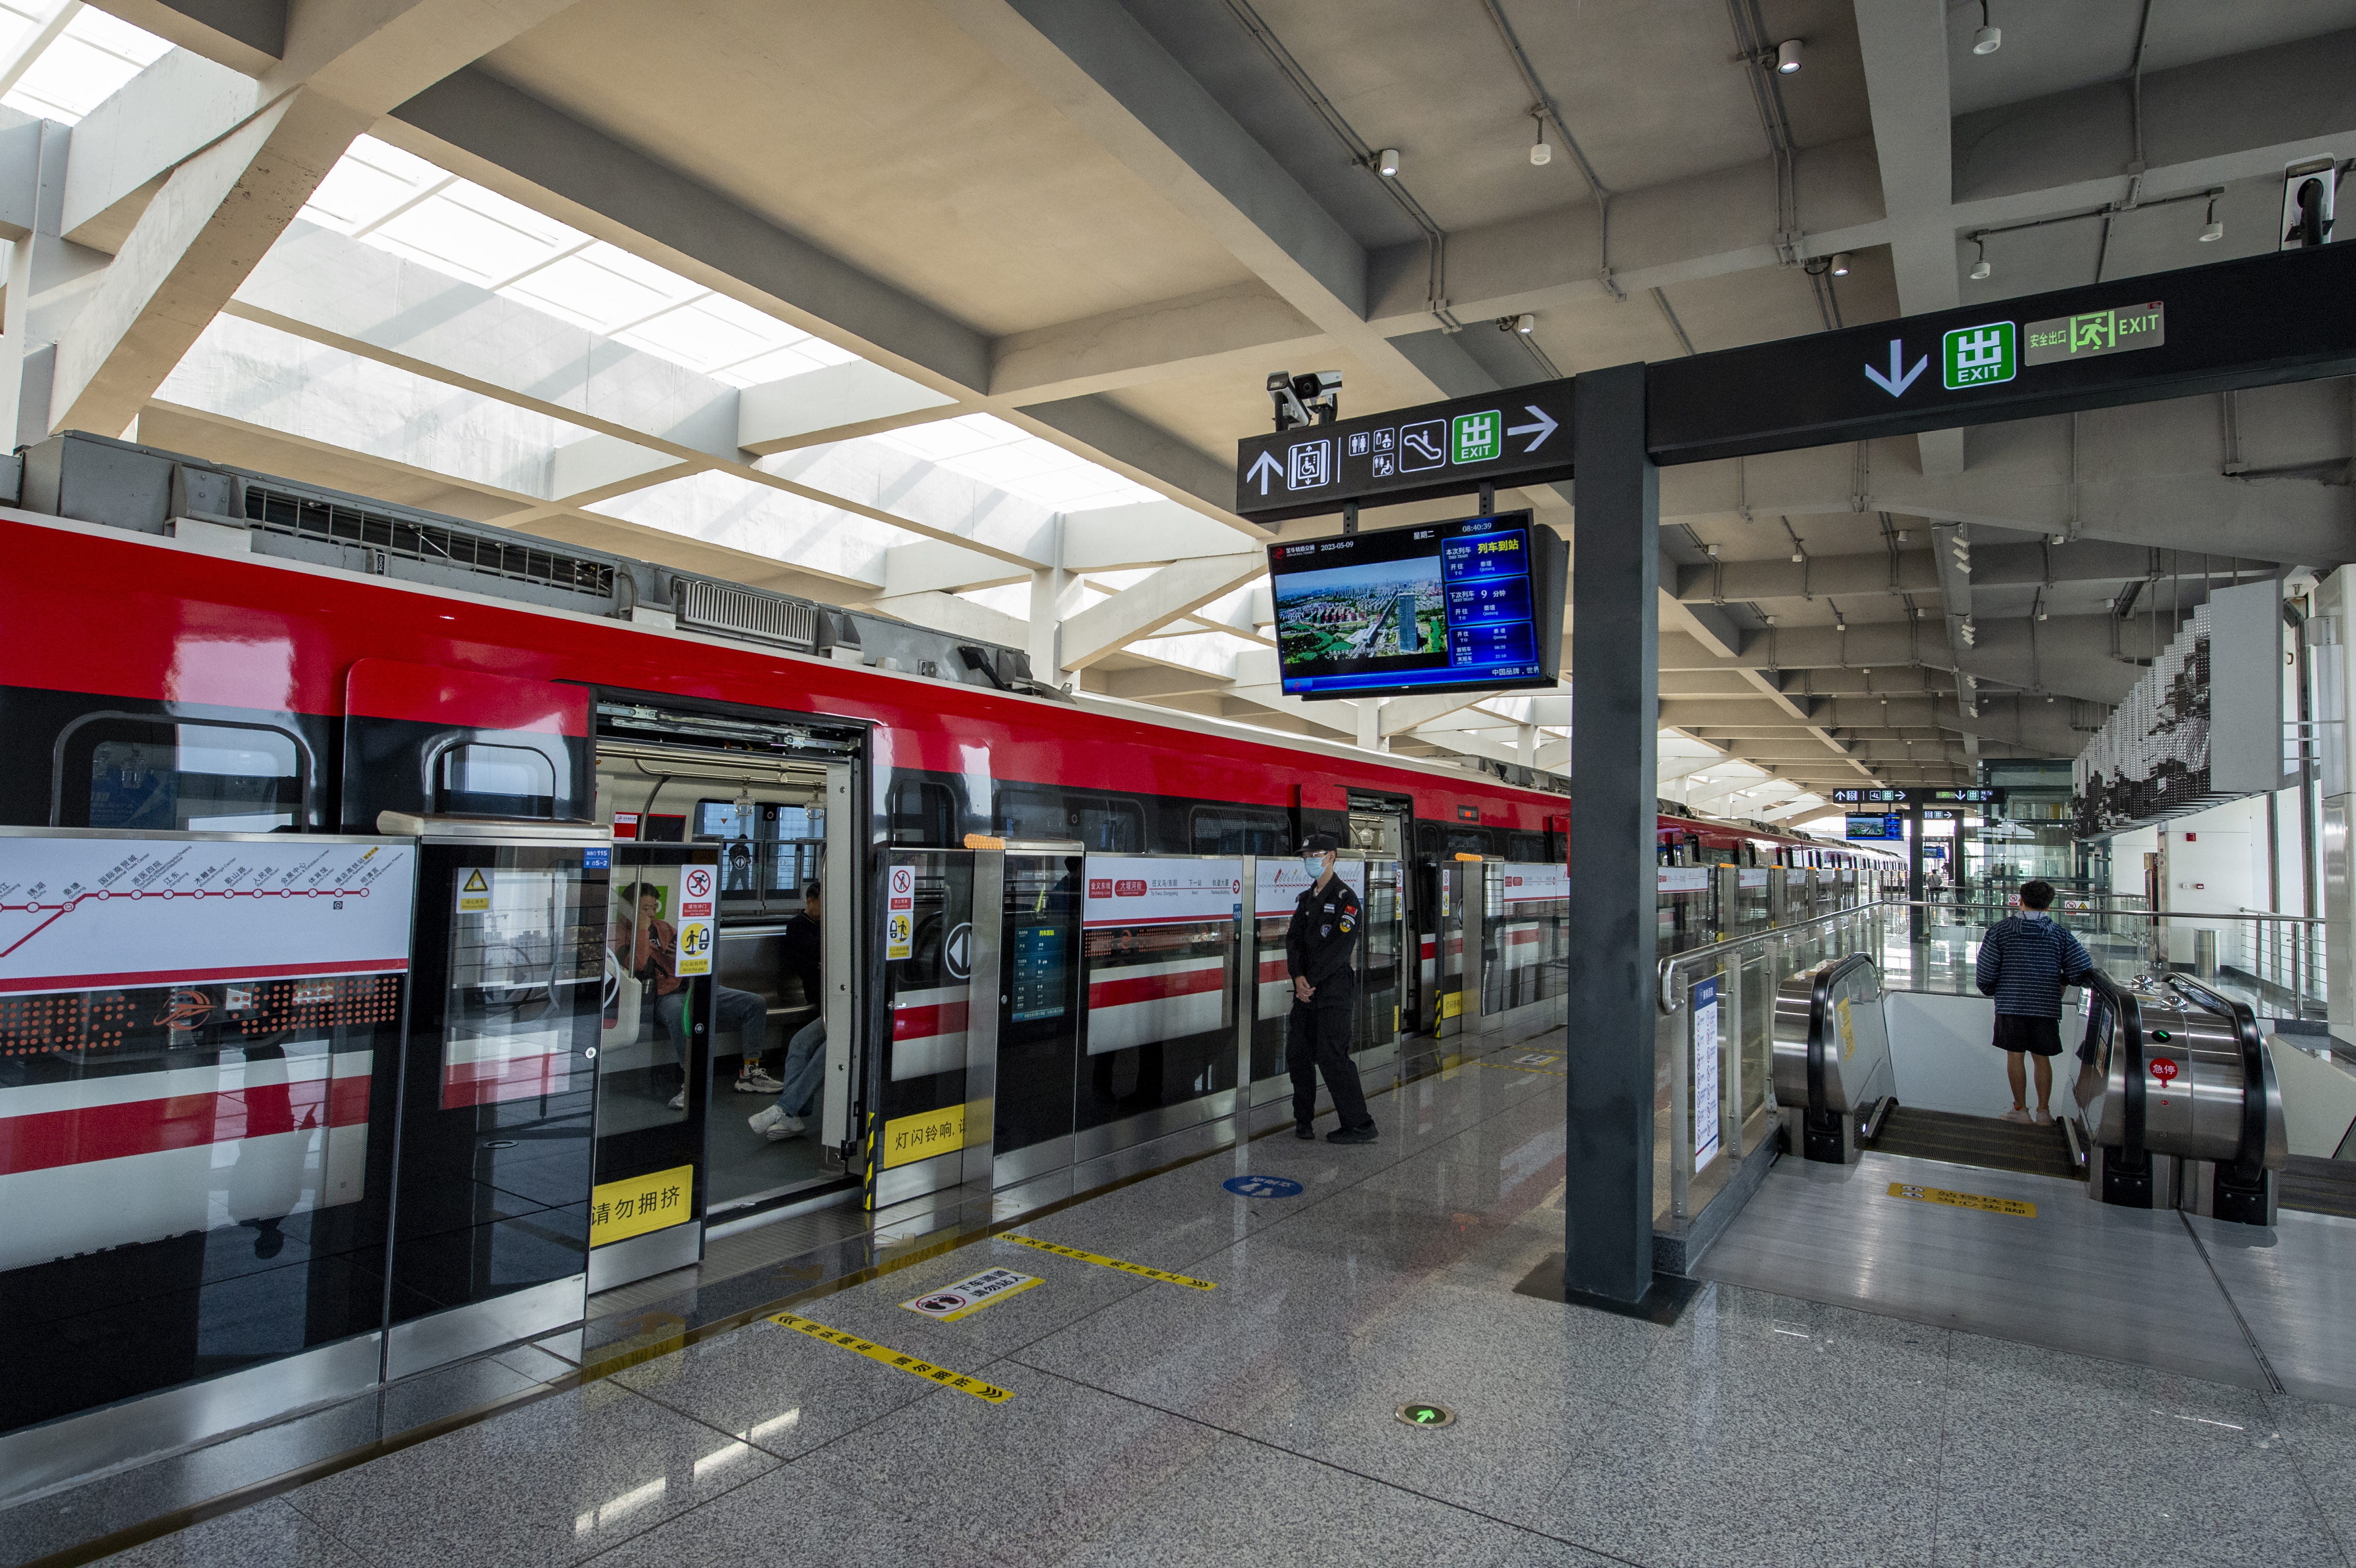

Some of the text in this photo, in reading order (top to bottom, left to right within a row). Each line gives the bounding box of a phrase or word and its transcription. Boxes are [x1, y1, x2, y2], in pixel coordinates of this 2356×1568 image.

[2119, 314, 2159, 335] EXIT
[2030, 330, 2066, 348] 安全出口
[1958, 330, 2001, 369] 出
[1958, 364, 2001, 382] EXIT
[1462, 416, 1491, 447] 出
[1462, 445, 1491, 459] EXIT
[1414, 530, 1435, 540] 星期二
[1462, 523, 1492, 532] 08:40:39
[1286, 544, 1315, 554] 金华轨道交通
[1321, 541, 1353, 551] 2023-05-09
[1446, 547, 1471, 556] 本次列车
[1478, 539, 1518, 554] 列车到站
[1450, 590, 1475, 599] 下次列车
[1481, 590, 1487, 599] 9
[1493, 589, 1506, 598] 分钟
[98, 854, 138, 885] 国际商贸城
[104, 853, 150, 888] International Trade Center
[131, 860, 163, 884] 浙医四院
[163, 871, 180, 884] 江东
[194, 866, 216, 884] 木雕城
[198, 857, 236, 888] Woodcarvings Center
[224, 866, 246, 884] 歌山路
[243, 867, 254, 877] Road
[253, 866, 273, 884] 人民路
[256, 868, 280, 887] Renmin Road
[281, 862, 306, 884] 会展中心
[308, 867, 328, 884] 体育馆
[312, 868, 335, 887] Sports Center
[335, 858, 365, 883] 横店高铁站
[360, 867, 379, 883] 明清宫
[169, 872, 189, 888] Jiangdong
[284, 872, 303, 887] Conference
[1091, 882, 1111, 890] 金义东线
[1120, 881, 1142, 890] 大堰河街
[33, 890, 46, 900] Xiuhu
[63, 882, 80, 896] 秦塘
[68, 886, 87, 899] Qintang
[2152, 1064, 2175, 1075] 急停
[592, 1186, 680, 1226] 请勿拥挤
[1025, 1239, 1179, 1281] 文明礼让 先下后上
[953, 1270, 1011, 1291] 下车通道
[969, 1275, 1026, 1297] 请勿站人
[802, 1323, 972, 1387] 排队候车 请勿拥挤
